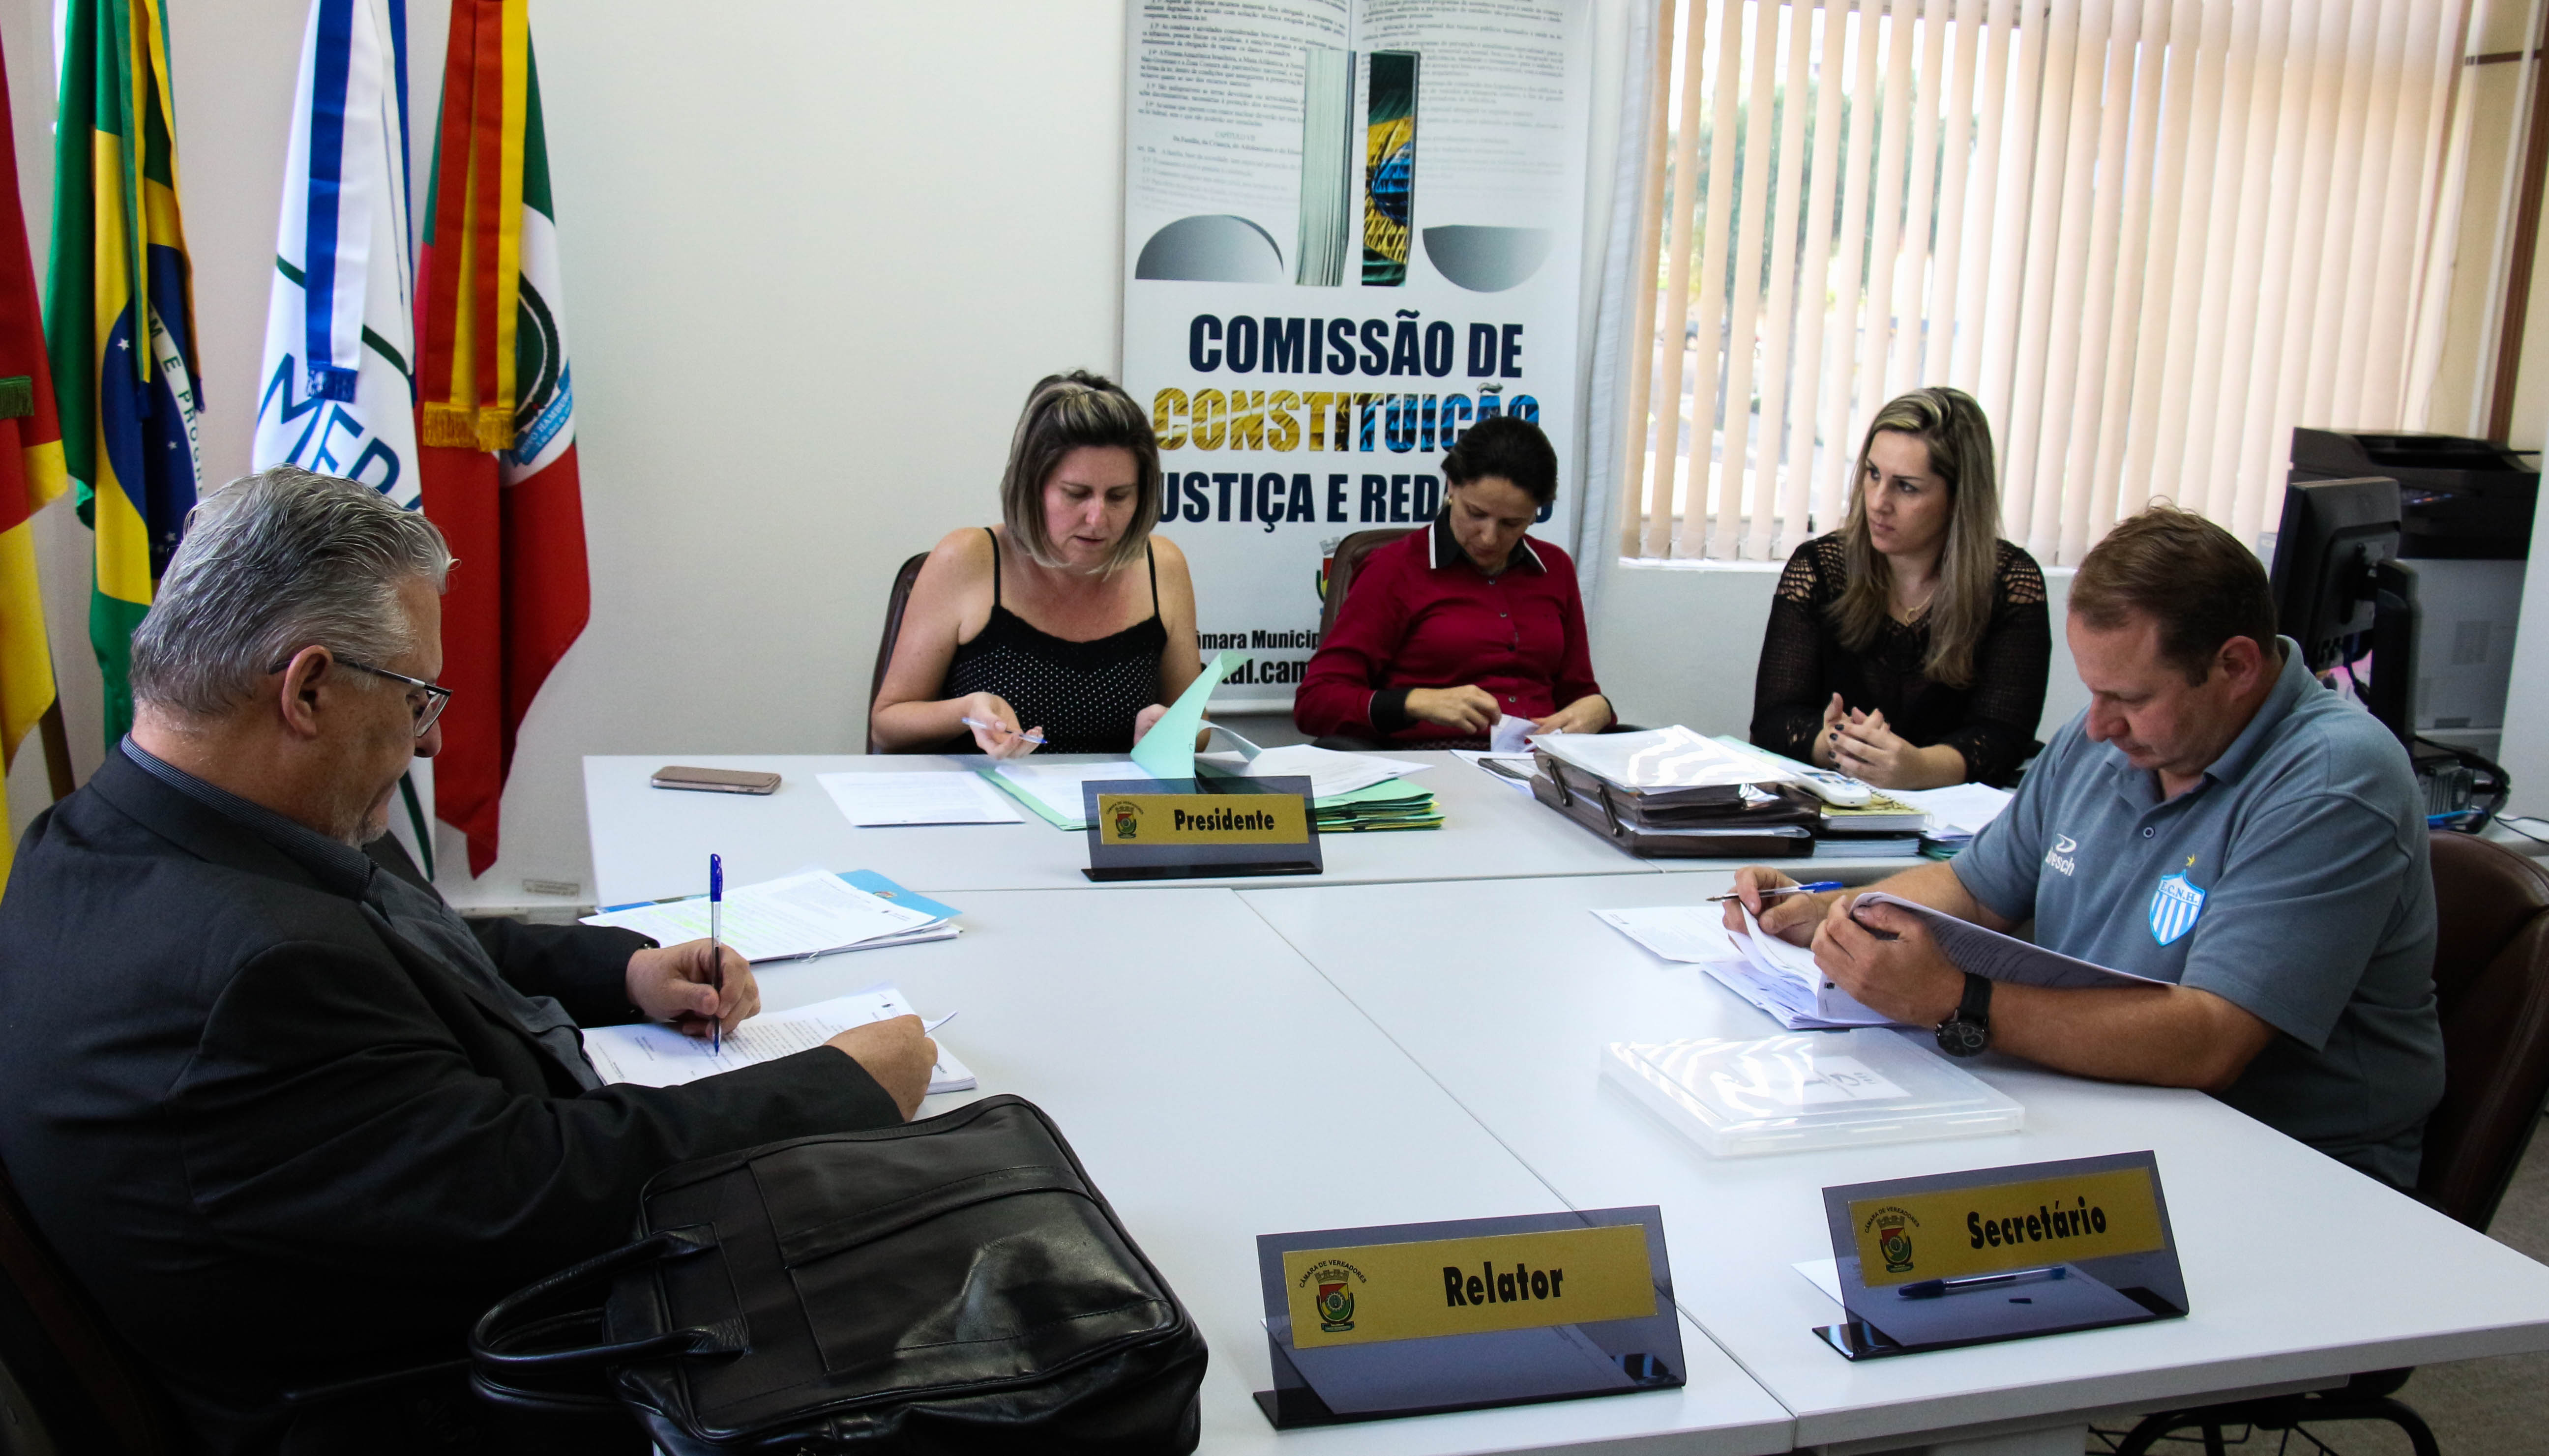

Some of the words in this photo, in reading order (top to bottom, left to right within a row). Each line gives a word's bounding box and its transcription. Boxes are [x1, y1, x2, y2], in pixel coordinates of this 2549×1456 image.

[1189, 309, 1454, 378] COMISSÃO
[1468, 323, 1523, 378] DE
[163, 356, 181, 373] E
[1159, 471, 1315, 533] USTIÇA
[1327, 474, 1348, 523] E
[1252, 630, 1319, 650] Municip
[1174, 808, 1274, 831] Presidente
[1967, 1196, 2106, 1250] Secretário
[1299, 1265, 1319, 1288] CÂMARA
[1329, 1259, 1367, 1283] VEREADORES
[1443, 1261, 1564, 1307] Relator
